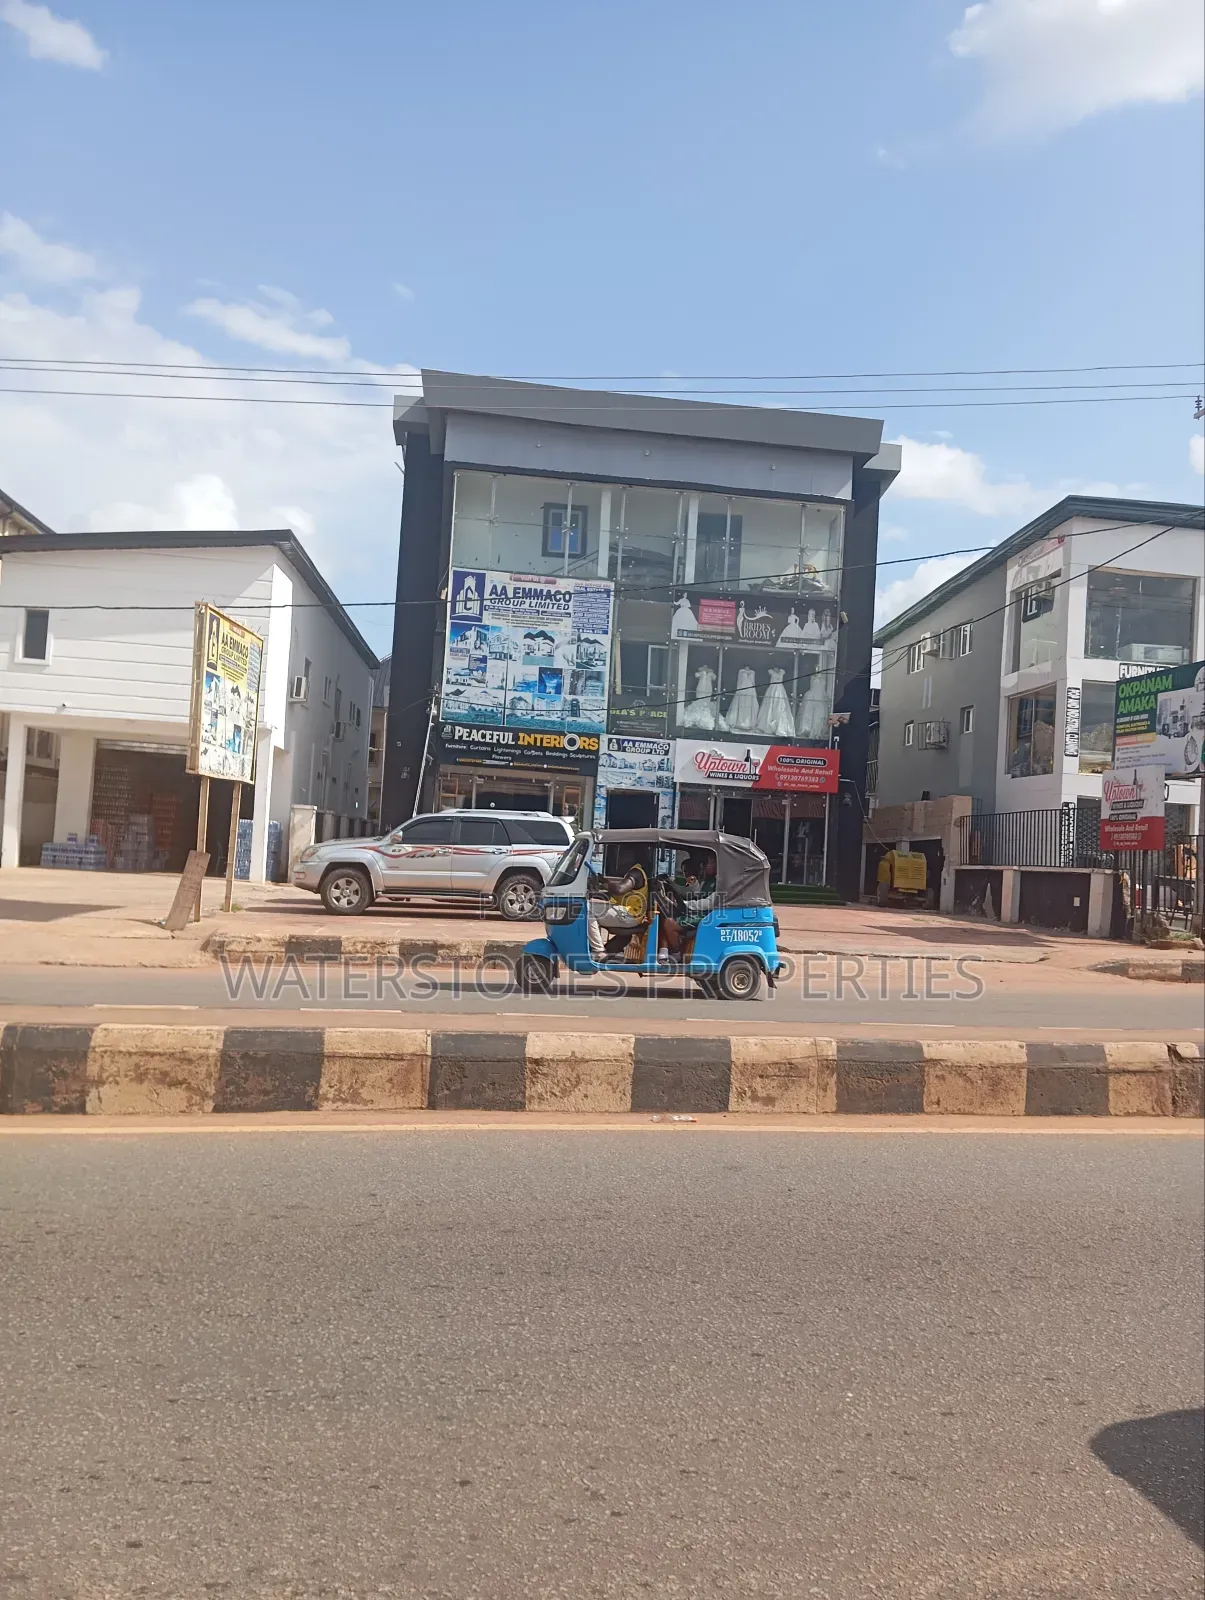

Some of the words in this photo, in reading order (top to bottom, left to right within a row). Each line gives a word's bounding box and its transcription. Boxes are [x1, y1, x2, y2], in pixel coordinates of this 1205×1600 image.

[489, 584, 509, 599] AA
[513, 587, 572, 603] EMMACO
[490, 598, 526, 607] GROUP
[528, 601, 570, 611] LIMITED
[743, 621, 771, 631] BRIDES
[221, 632, 228, 648] AA
[743, 629, 769, 640] ROOM
[1118, 674, 1173, 698] OKPANAM
[1117, 695, 1156, 714] AMAKA
[454, 725, 515, 744] PEACEFUL
[518, 732, 599, 751] INTERIORS
[635, 741, 669, 750] EMMACO
[545, 750, 568, 758] Beddings
[694, 751, 748, 776] Uptown
[767, 765, 800, 773] Wholesale
[815, 768, 833, 776] Retail
[1104, 781, 1137, 808] Uptown
